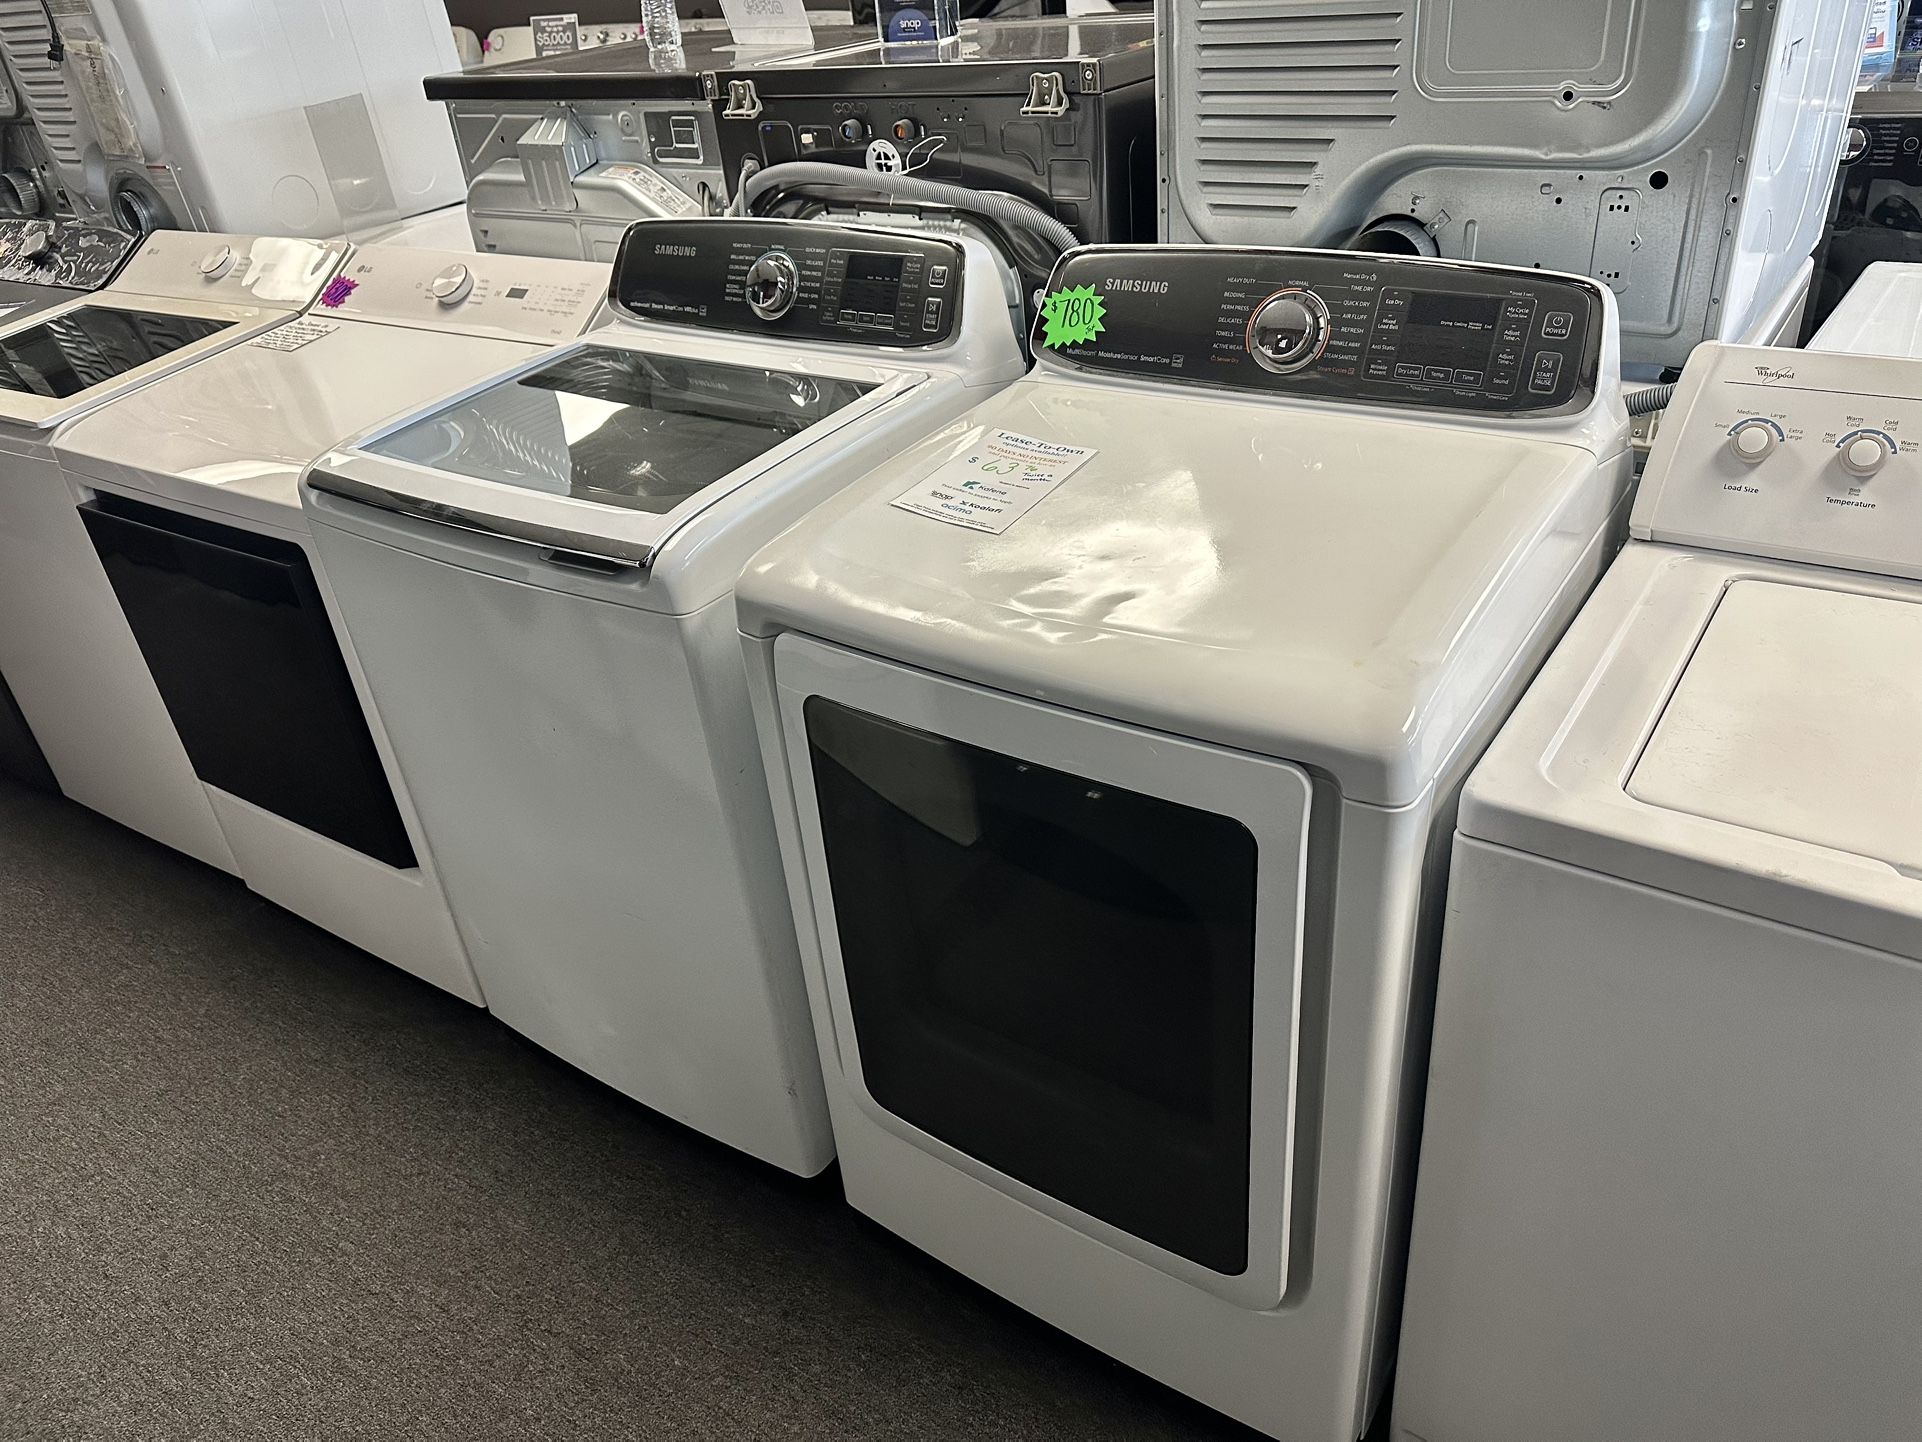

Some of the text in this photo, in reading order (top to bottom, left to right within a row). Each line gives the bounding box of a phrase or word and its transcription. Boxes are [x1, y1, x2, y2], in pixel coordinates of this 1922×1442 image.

[900, 20, 921, 30] snap
[536, 31, 572, 46] $5,000
[833, 102, 868, 113] COLD
[655, 244, 697, 257] SAMSUNG
[1104, 278, 1169, 294] SAMSUNG
[1223, 291, 1246, 299] BEDDING
[1218, 316, 1243, 324] DELICATES
[1545, 327, 1567, 335] POWER
[1098, 351, 1139, 361] MoistureSensor
[1140, 354, 1170, 364] SmartCare
[1398, 367, 1406, 375] Dry
[1756, 369, 1795, 380] Whirlpool
[1492, 377, 1509, 385] Sound
[1736, 408, 1760, 416] Medium
[1770, 411, 1787, 420] Large
[1714, 421, 1730, 430] Small
[1788, 427, 1804, 435] Extra
[1824, 431, 1836, 439] Hot
[1786, 433, 1803, 441] Large
[1822, 437, 1836, 445] Cold
[997, 432, 1085, 455] Lease-To-Own
[1002, 441, 1029, 451] options
[968, 456, 979, 465] $
[997, 446, 1016, 456] DAYS
[1028, 455, 1069, 465] INTEREST
[981, 459, 1020, 476] 63
[1723, 483, 1760, 494] Load Size
[969, 501, 1003, 513] Koalafi
[1825, 496, 1877, 510] Temperature
[941, 503, 973, 515] acima
